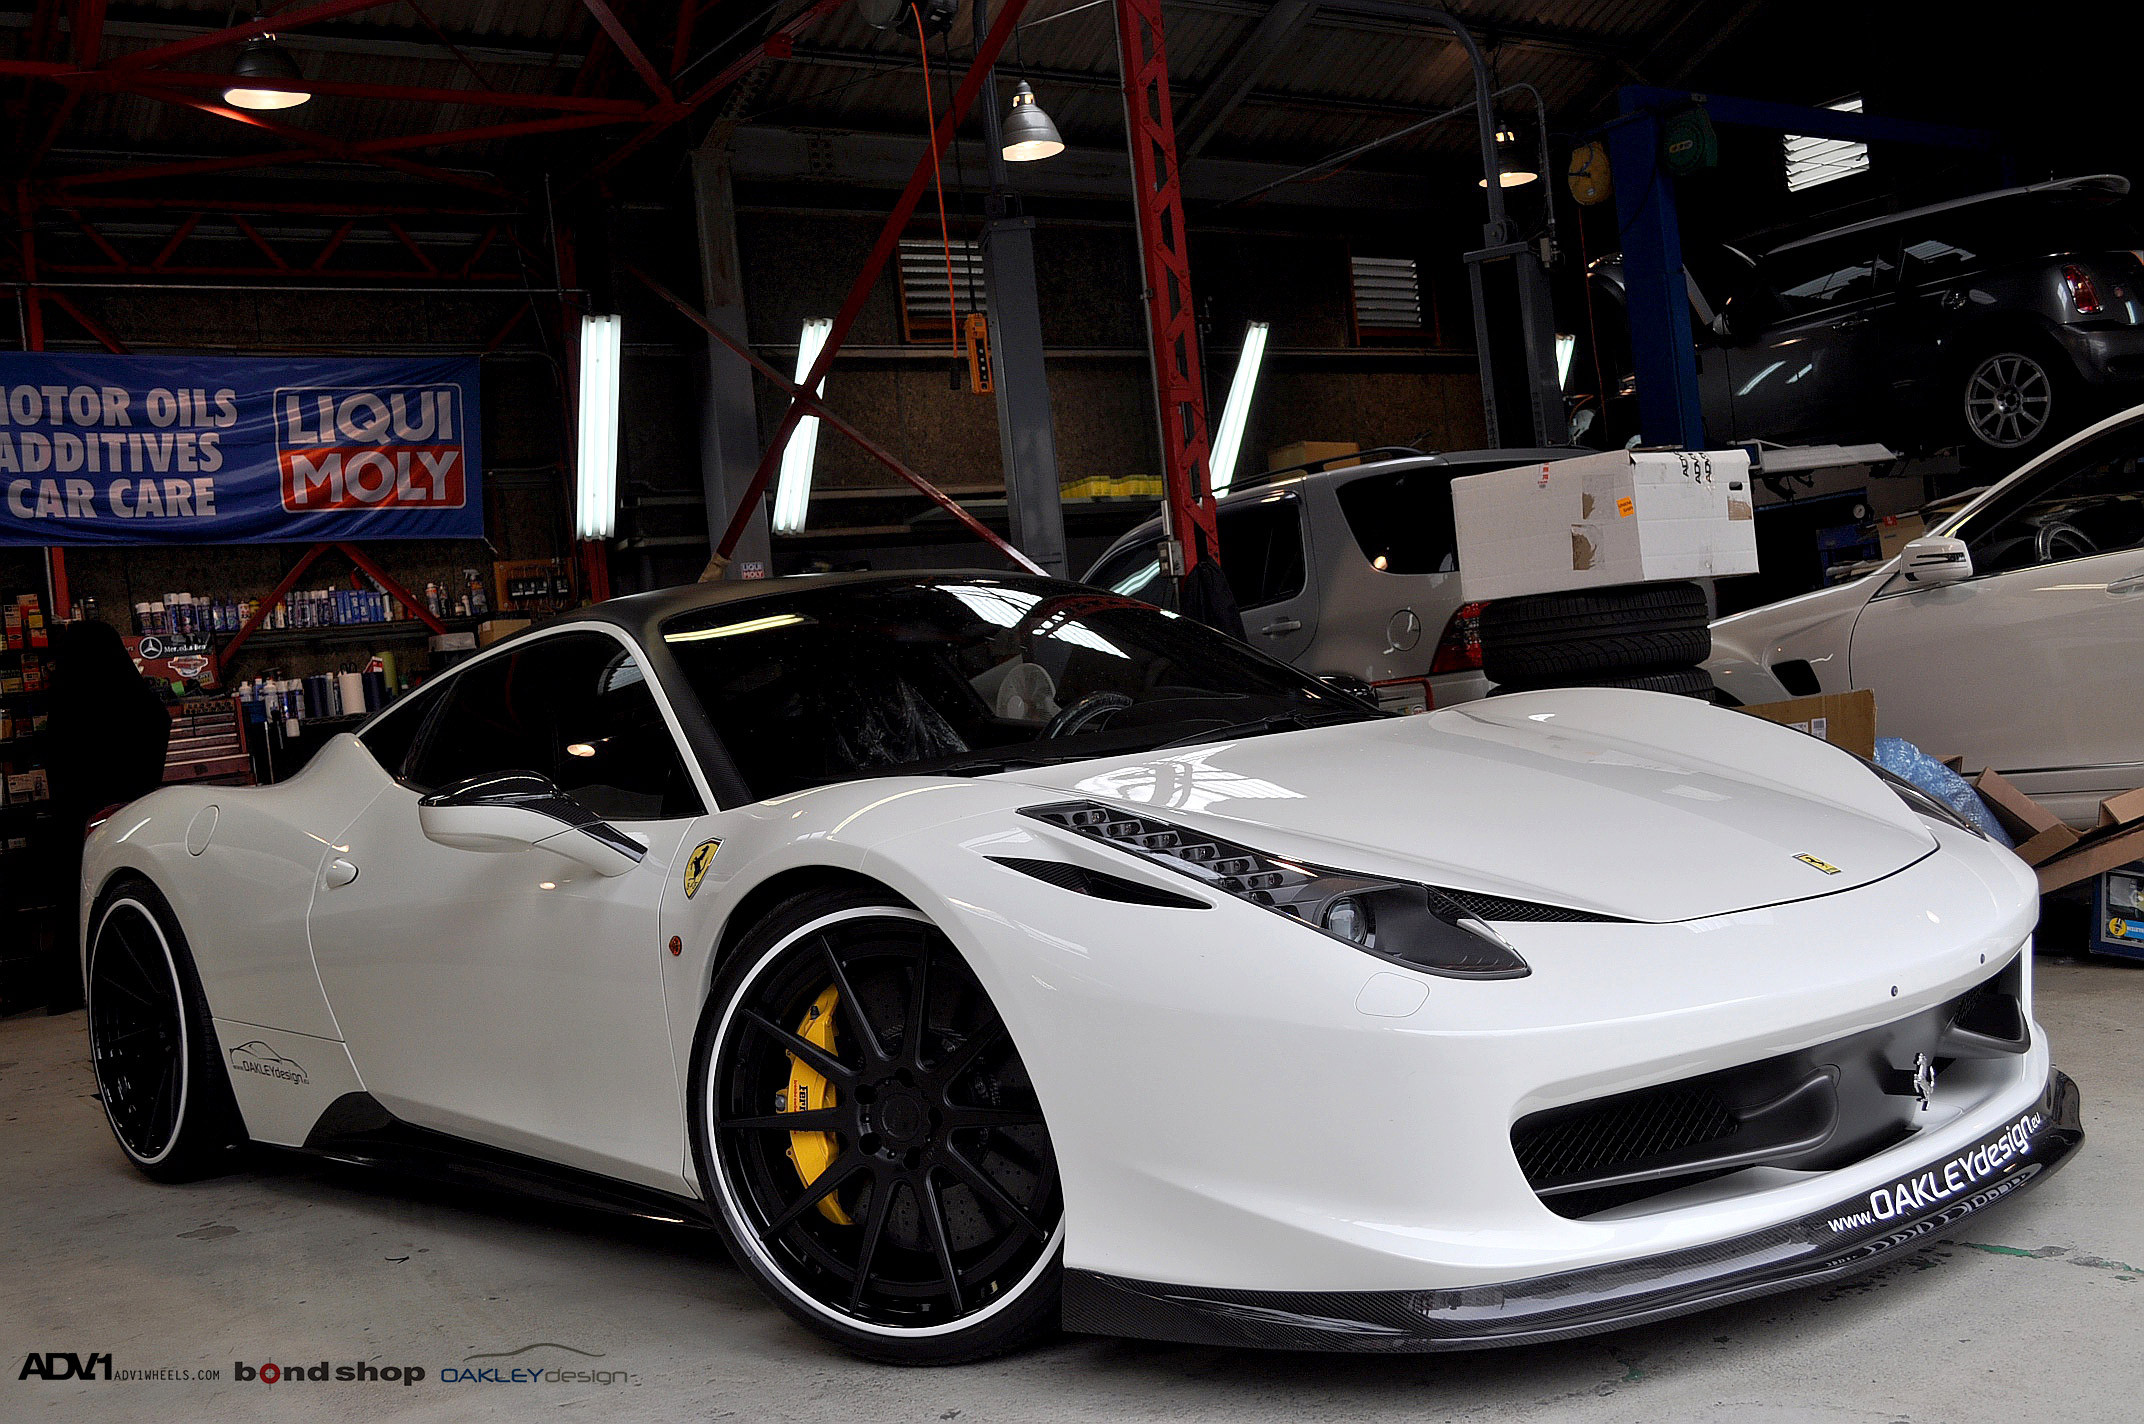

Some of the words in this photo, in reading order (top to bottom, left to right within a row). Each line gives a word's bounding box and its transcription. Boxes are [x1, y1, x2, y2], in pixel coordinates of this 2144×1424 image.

[146, 388, 238, 428] OILS
[287, 390, 454, 443] LIQUI
[0, 432, 224, 473] ADDITIVES
[8, 478, 98, 519] CAR
[108, 477, 217, 517] CARE
[290, 451, 460, 504] MOLY
[743, 571, 765, 579] MOLY
